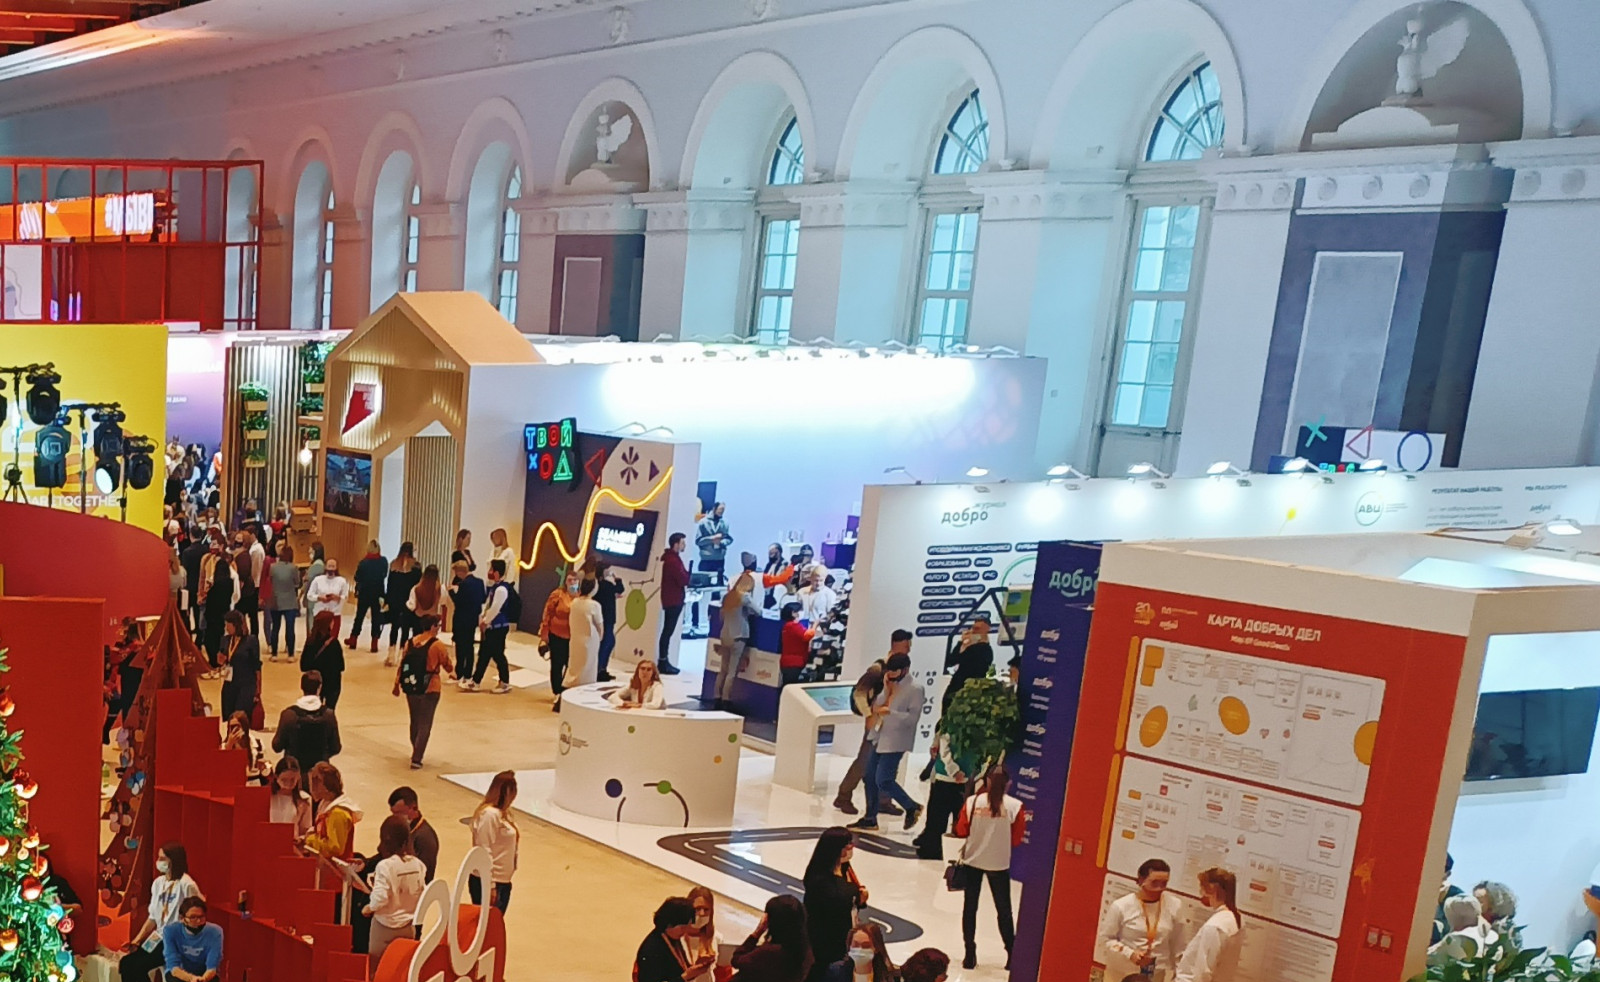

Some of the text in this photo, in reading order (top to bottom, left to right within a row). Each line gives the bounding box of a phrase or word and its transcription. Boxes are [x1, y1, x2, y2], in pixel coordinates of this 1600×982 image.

[525, 420, 572, 449] ТВОЙ
[528, 451, 573, 481] ХОД
[58, 495, 118, 507] TOGETHE
[941, 508, 989, 525] добро
[1207, 613, 1243, 631] КАРТА
[1244, 619, 1295, 639] ДОБРЫХ
[1295, 628, 1322, 642] ДЕЛ
